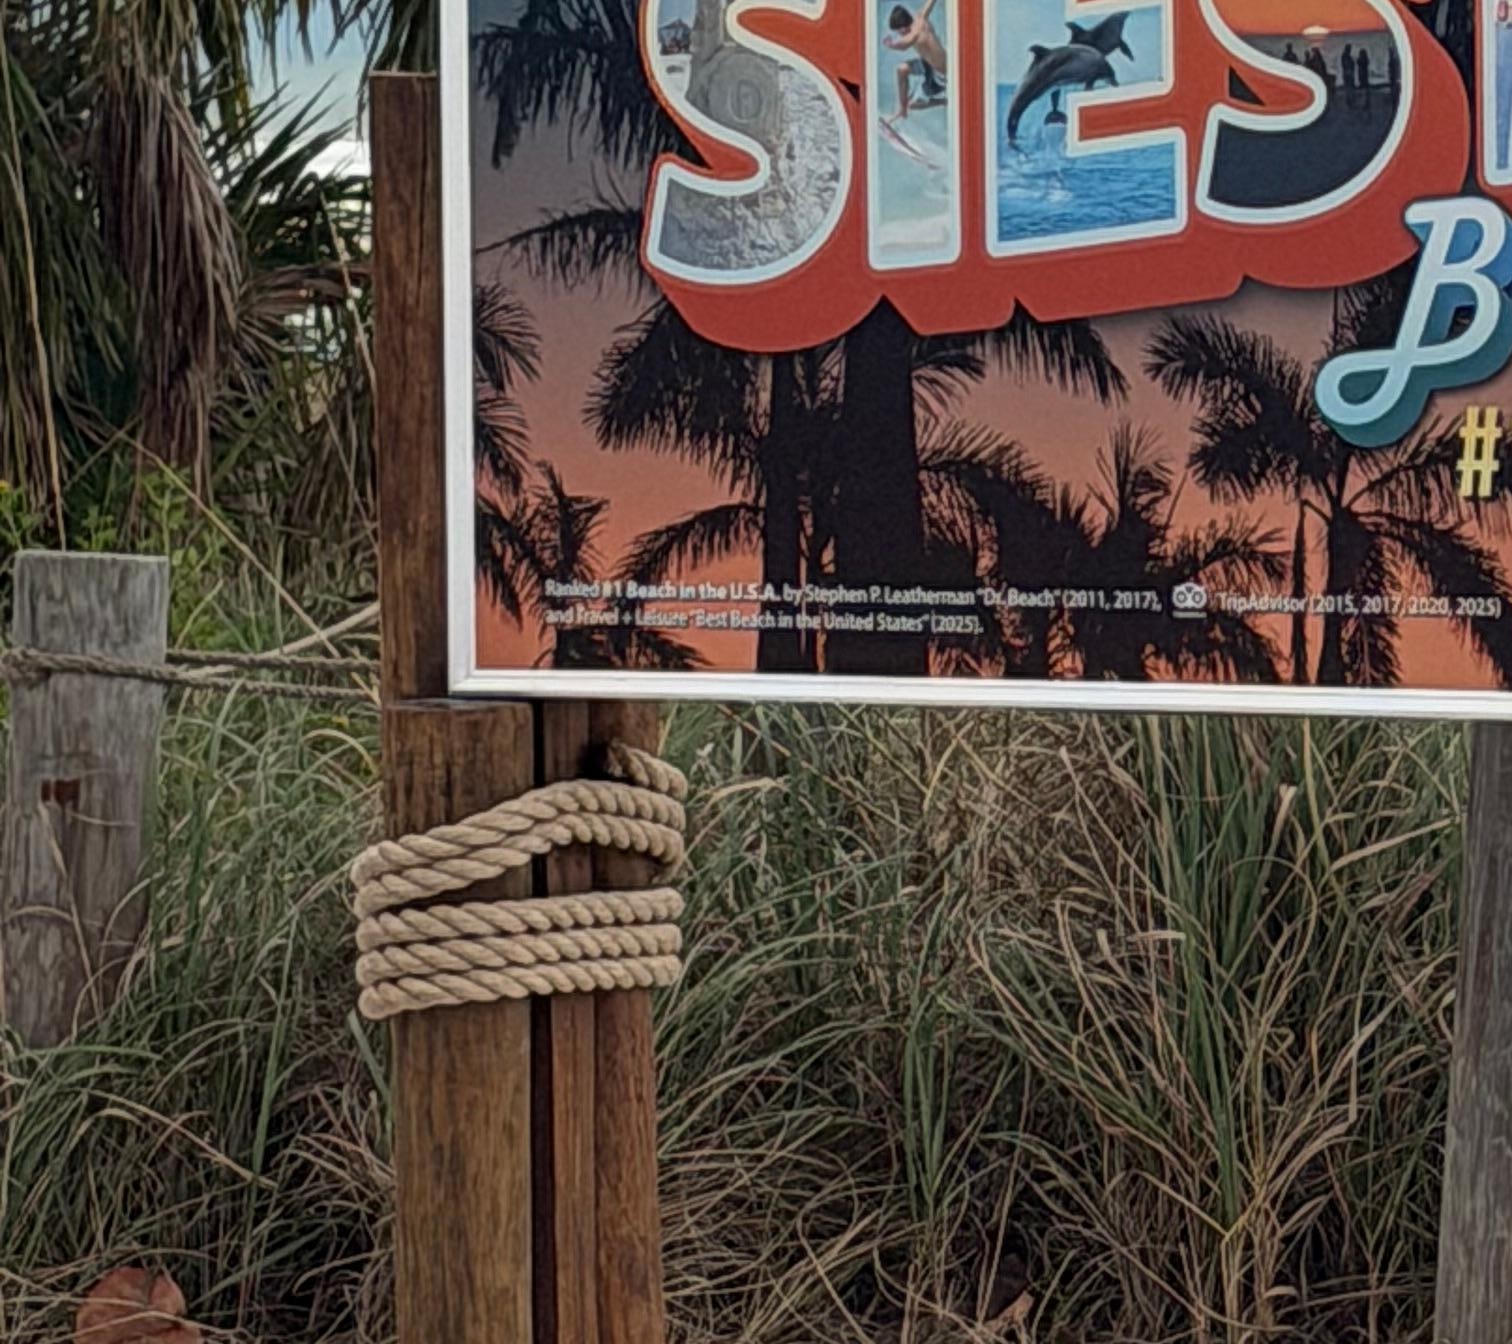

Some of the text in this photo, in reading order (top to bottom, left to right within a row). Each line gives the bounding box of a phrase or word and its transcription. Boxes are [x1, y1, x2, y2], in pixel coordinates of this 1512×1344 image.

[545, 578, 600, 598] Ranked
[602, 580, 622, 598] #1
[626, 579, 676, 599] Beach
[679, 579, 696, 599] in
[698, 581, 728, 600] the
[730, 582, 781, 602] U.S.A.
[783, 582, 803, 606] by
[804, 582, 868, 607] Stephen
[869, 584, 882, 604] P.
[884, 584, 976, 605] Leatherman
[1062, 588, 1111, 611] (2011,
[1112, 590, 1163, 613] 2017),
[1219, 592, 1305, 614] TripAdvisor
[1309, 593, 1359, 616] (2015,
[1407, 595, 1453, 618] 2020,
[1455, 596, 1502, 619] 2025)
[545, 605, 574, 624] and
[575, 603, 619, 626] Travel
[635, 607, 688, 627] Leisure
[730, 609, 776, 629] Beach
[777, 610, 793, 628] in
[796, 611, 821, 630] the
[823, 611, 874, 632] United
[931, 612, 984, 635] (2025).
